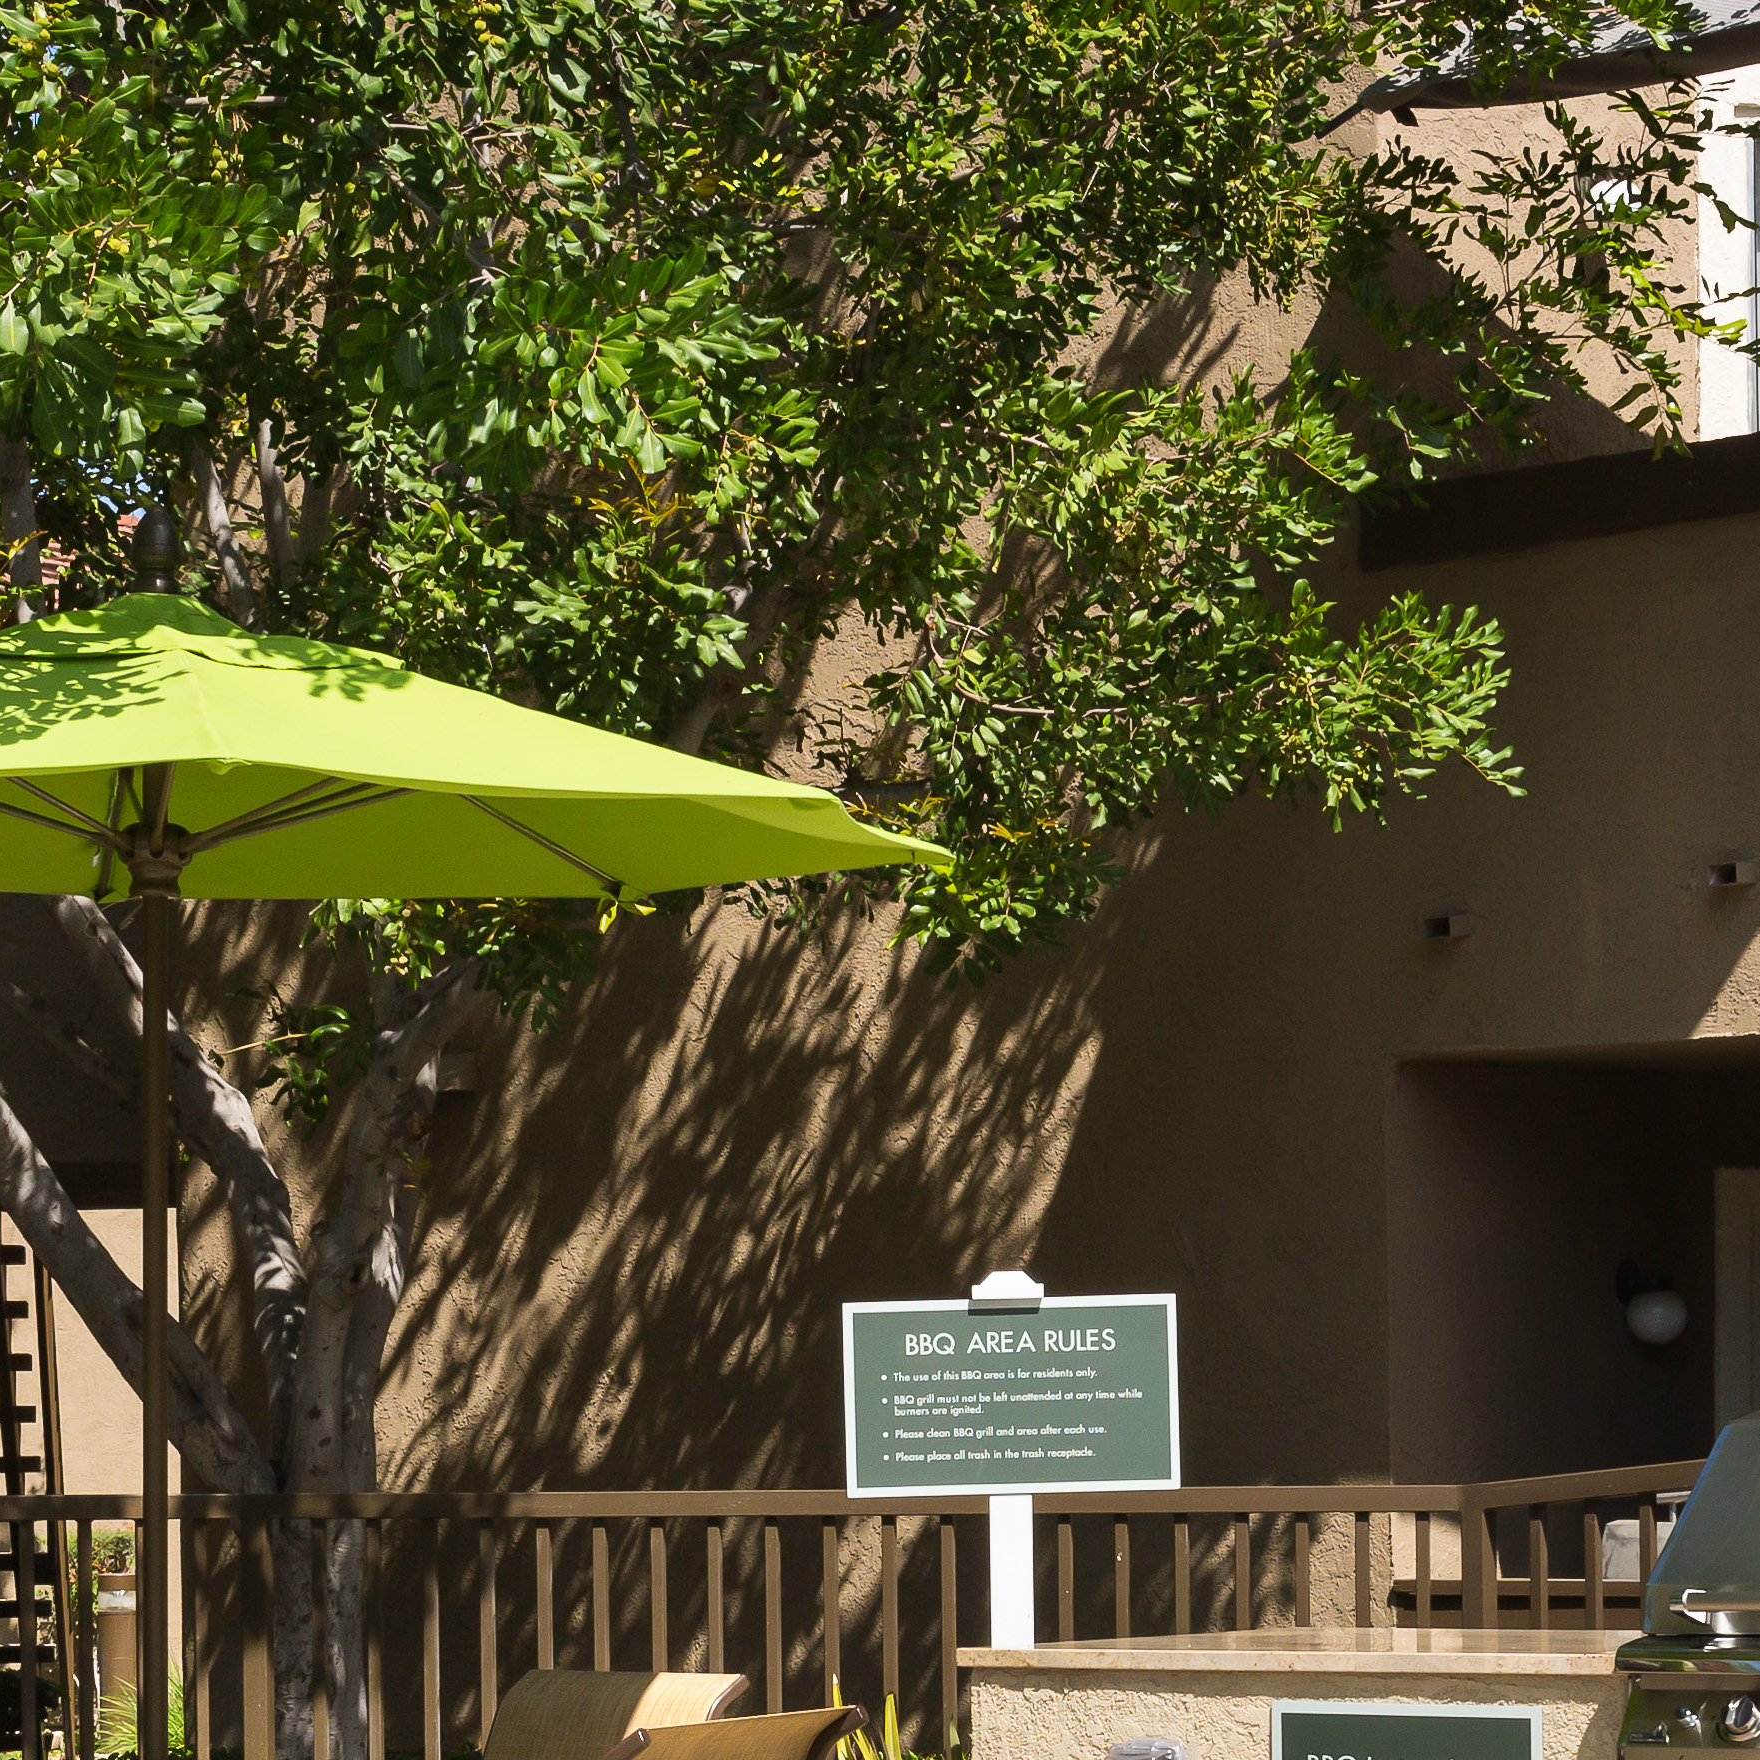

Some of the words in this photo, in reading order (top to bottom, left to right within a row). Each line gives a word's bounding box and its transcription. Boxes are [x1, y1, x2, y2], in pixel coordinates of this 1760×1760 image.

[905, 1332, 956, 1355] BBQ
[966, 1330, 1037, 1354] AREA
[1044, 1328, 1116, 1352] RULES
[893, 1371, 911, 1381] The
[931, 1369, 942, 1380] of
[943, 1370, 960, 1380] this
[960, 1369, 982, 1379] BBQ
[1007, 1369, 1015, 1378] is
[1017, 1367, 1031, 1378] for
[1032, 1366, 1074, 1378] residents
[1075, 1366, 1098, 1379] only.
[893, 1394, 915, 1404] BBQ
[916, 1393, 935, 1406] grill
[936, 1394, 960, 1403] must
[961, 1394, 977, 1402] not
[978, 1392, 991, 1402] be
[993, 1391, 1008, 1401] left
[1009, 1389, 1062, 1401] unattended
[1063, 1391, 1074, 1399] at
[1075, 1392, 1094, 1401] any
[1095, 1389, 1116, 1399] time
[1117, 1388, 1143, 1398] while
[894, 1403, 930, 1416] burners
[950, 1403, 984, 1416] ignited.
[894, 1428, 924, 1438] Please
[926, 1427, 951, 1437] clean
[953, 1427, 974, 1437] BBQ
[975, 1425, 994, 1439] grill
[995, 1425, 1015, 1436] and
[1039, 1424, 1062, 1434] after
[1063, 1423, 1086, 1434] each
[895, 1450, 925, 1461] Please
[926, 1450, 952, 1463] place
[953, 1449, 966, 1460] all
[967, 1448, 991, 1459] trash
[993, 1449, 1002, 1458] in
[1004, 1448, 1020, 1458] the
[1021, 1447, 1045, 1457] trash
